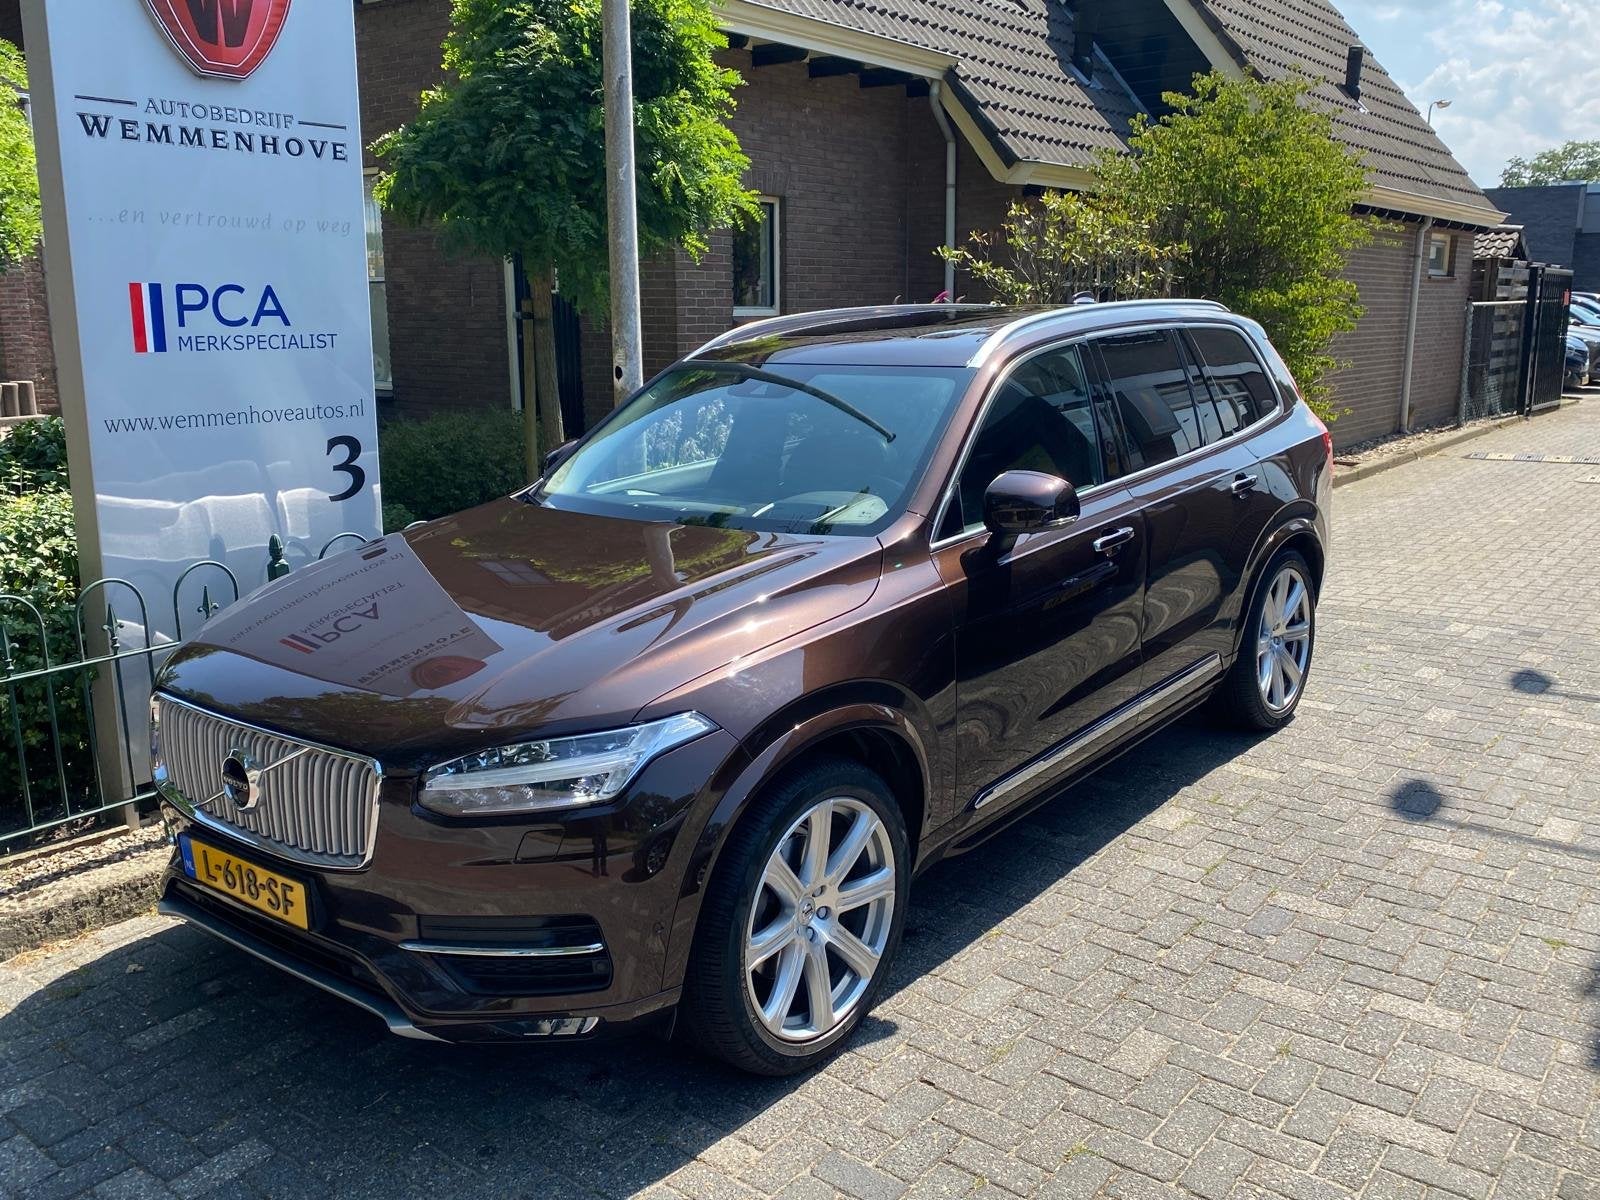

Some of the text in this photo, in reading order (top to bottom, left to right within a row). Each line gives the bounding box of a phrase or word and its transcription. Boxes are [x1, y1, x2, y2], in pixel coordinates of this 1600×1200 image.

[144, 99, 294, 130] AUTOBEDRIJF
[76, 112, 349, 163] WEMMENHOVE
[159, 209, 273, 231] vertrouwd
[283, 218, 307, 235] op
[317, 219, 352, 238] weg
[175, 283, 291, 328] PCA
[178, 333, 338, 352] MERKSPECIALIST
[104, 398, 365, 434] www.wemmenhoveautos.nl
[325, 435, 366, 502] 3
[202, 849, 295, 916] L-618-SF
